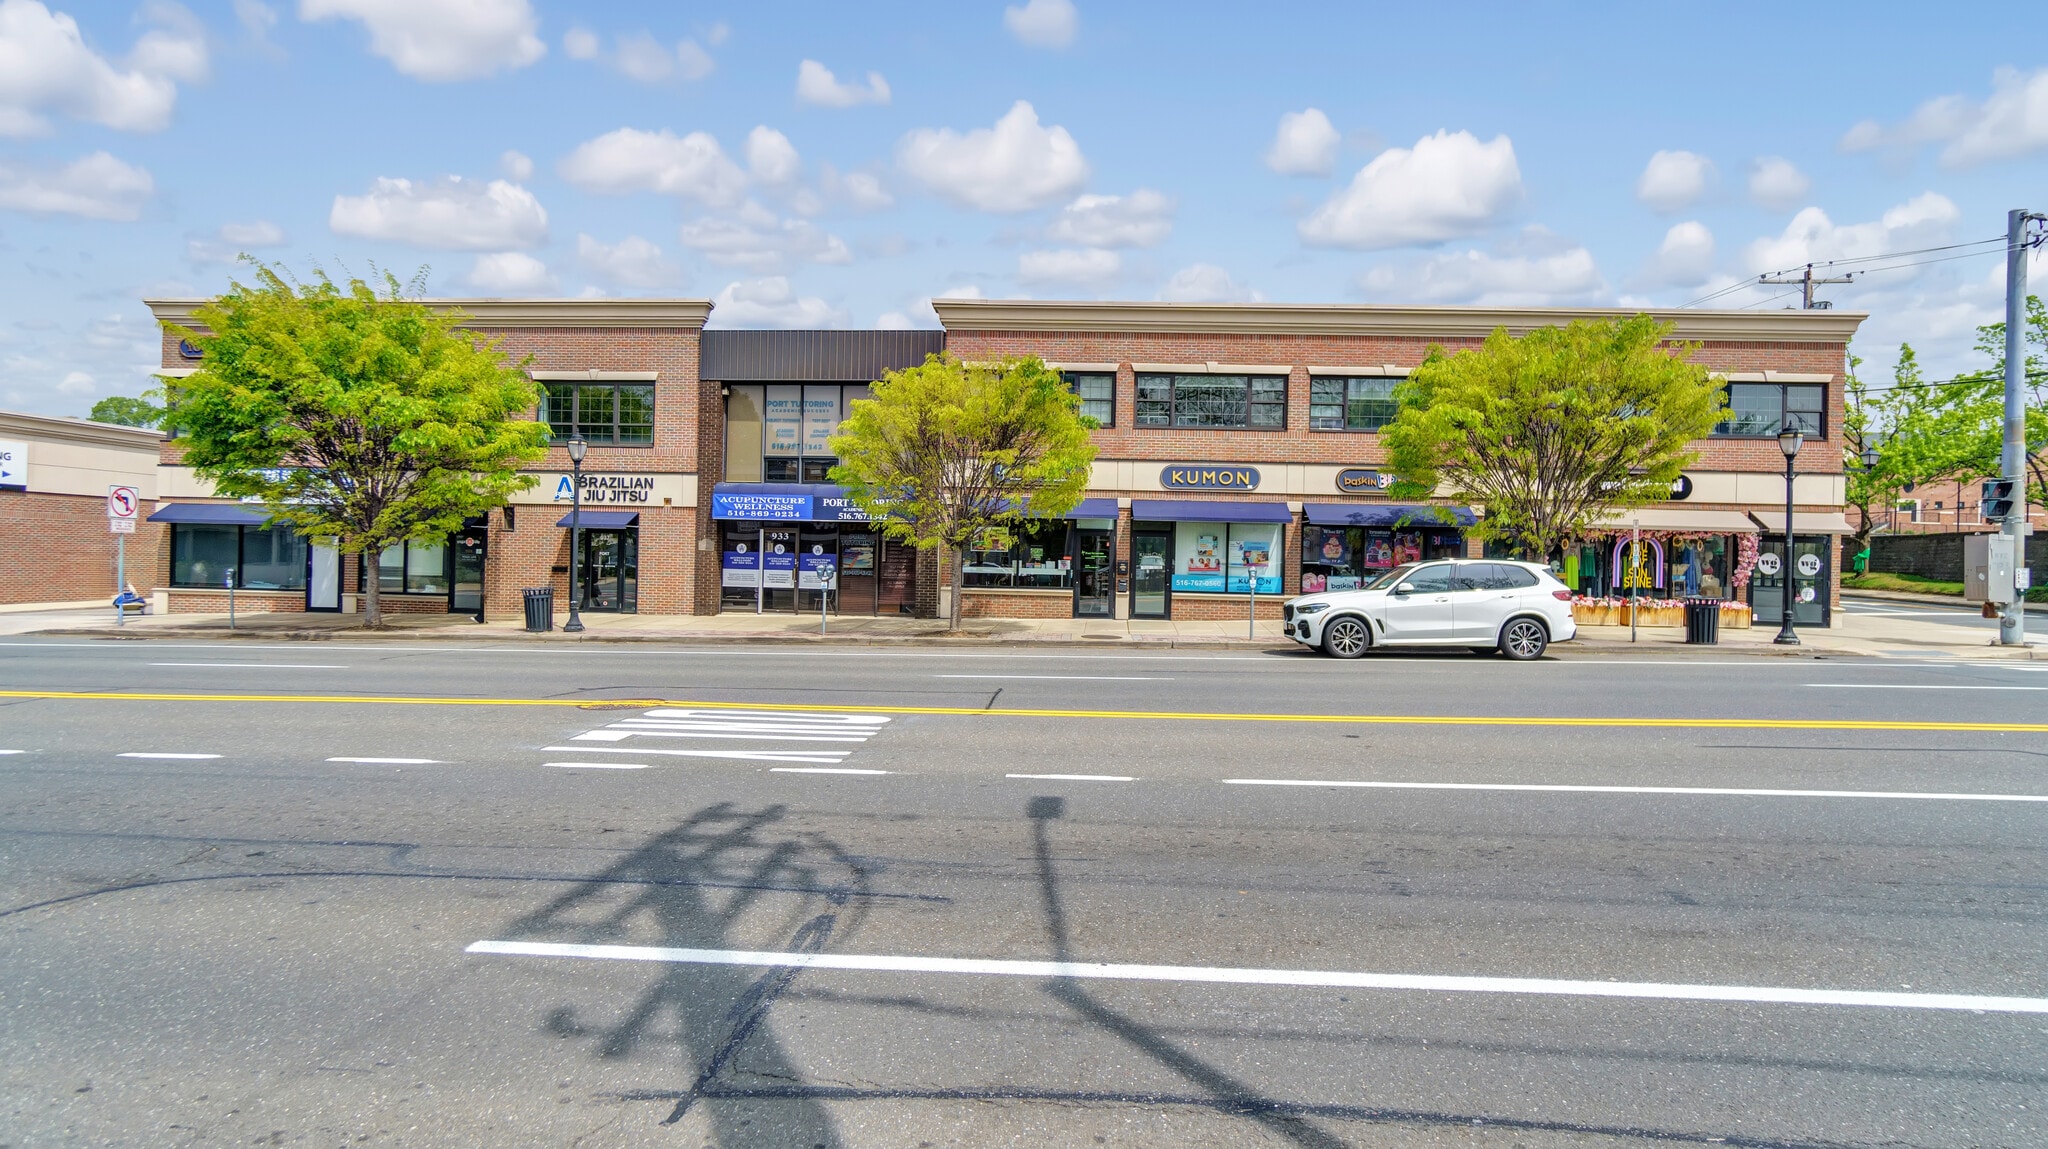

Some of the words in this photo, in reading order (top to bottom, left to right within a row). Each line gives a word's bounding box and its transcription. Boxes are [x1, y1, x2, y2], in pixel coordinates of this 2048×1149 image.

[1172, 470, 1251, 485] KUMON
[579, 477, 654, 489] BRAZILIAN
[584, 490, 606, 502] JIU
[609, 490, 649, 502] JITSU
[720, 496, 806, 505] ACUPUNCTURE
[733, 503, 794, 511] WELLNESS
[823, 498, 849, 507] PORT
[771, 532, 789, 540] 933
[1238, 577, 1272, 586] KUON
